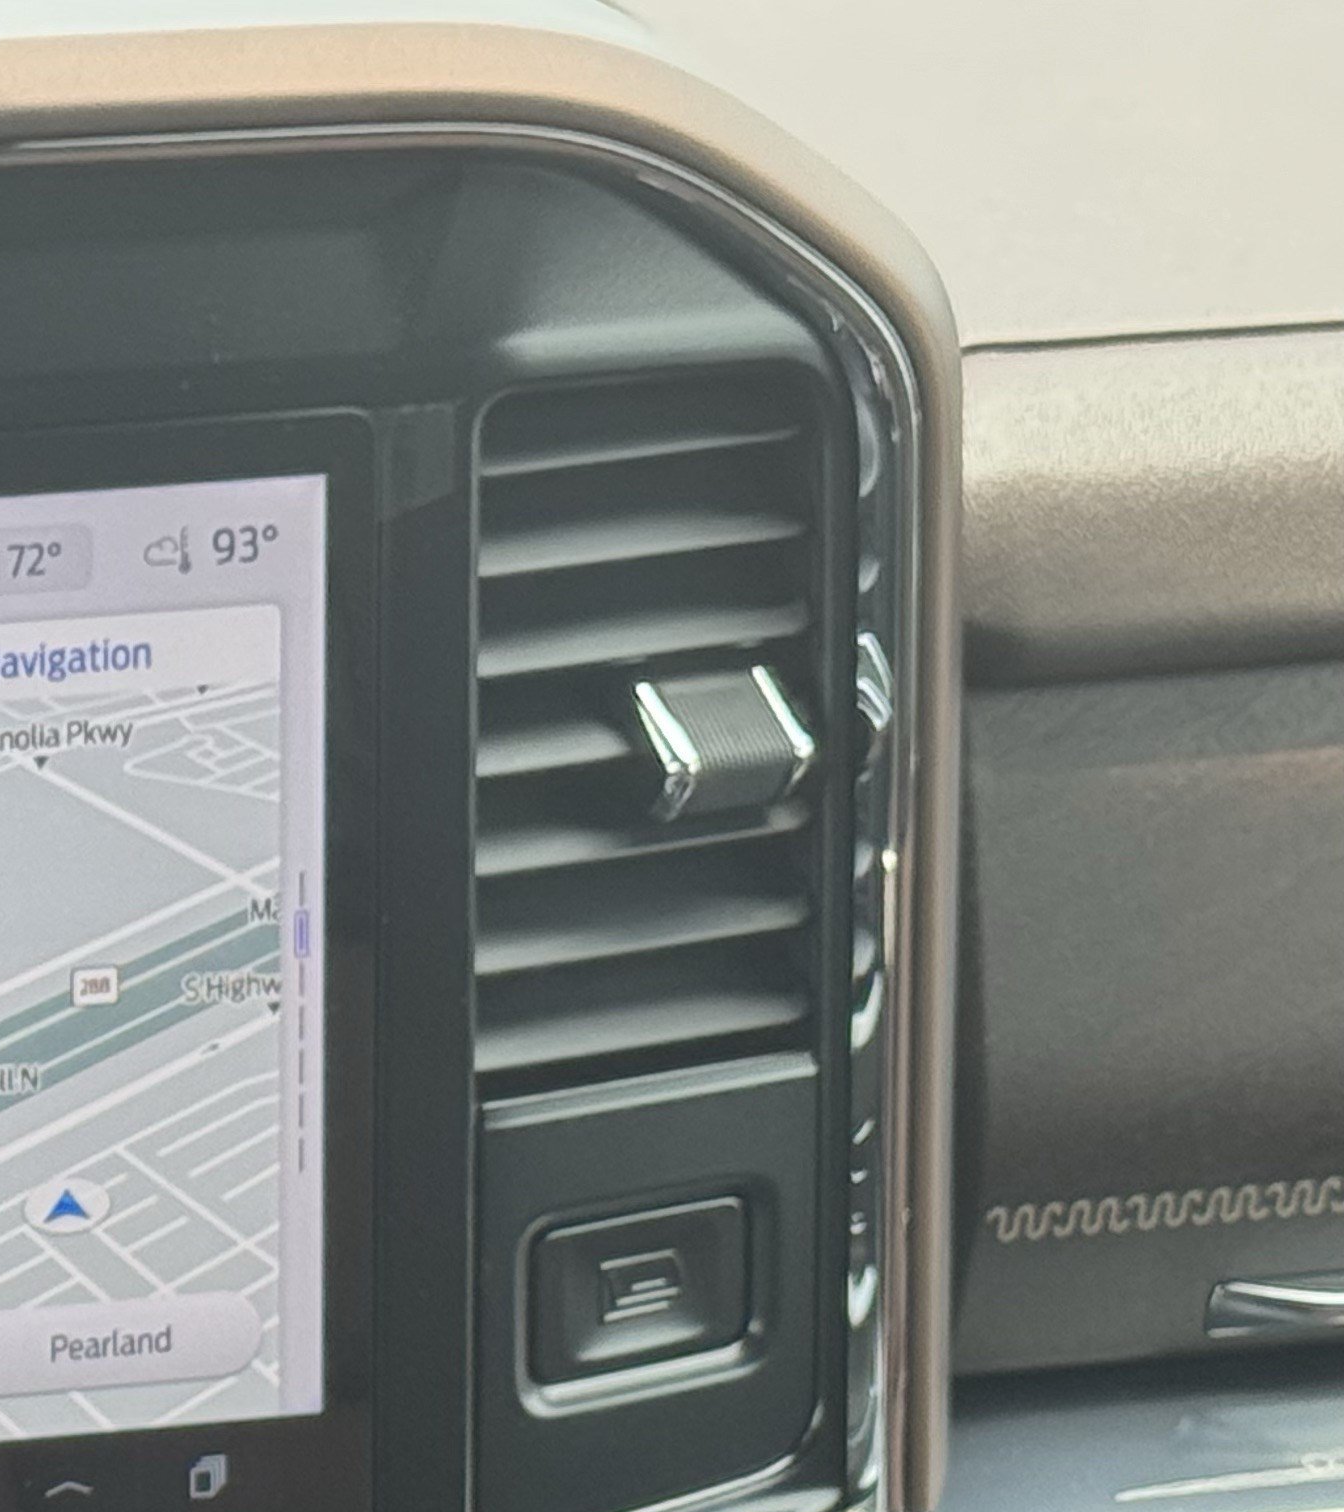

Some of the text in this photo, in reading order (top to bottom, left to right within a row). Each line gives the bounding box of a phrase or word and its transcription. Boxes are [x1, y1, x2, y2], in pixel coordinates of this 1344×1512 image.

[8, 542, 62, 579] 72°
[212, 523, 279, 565] 93°
[66, 721, 134, 748] Pkwy
[20, 1067, 39, 1091] N
[50, 1325, 173, 1363] Pearland
